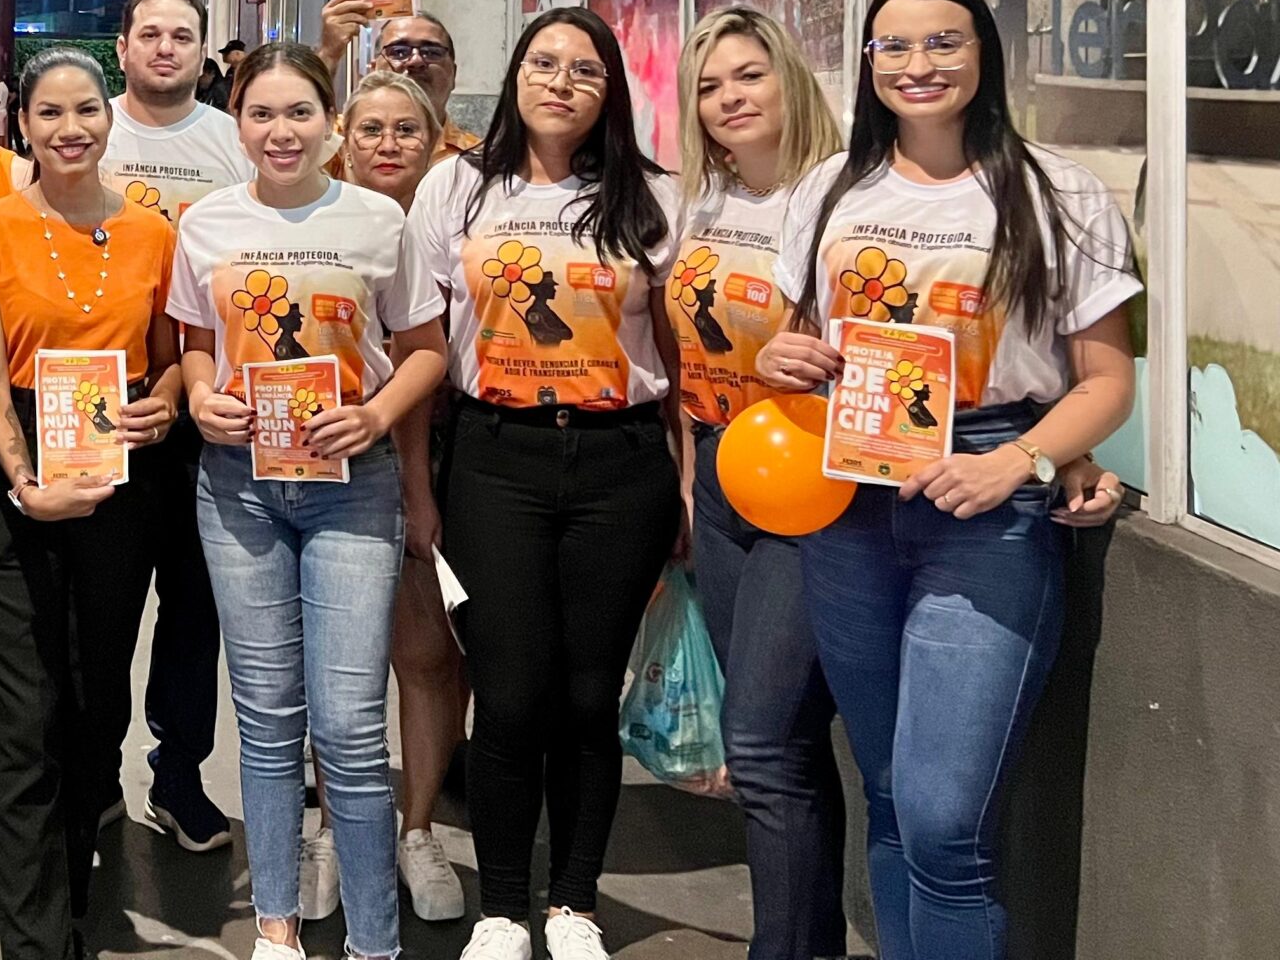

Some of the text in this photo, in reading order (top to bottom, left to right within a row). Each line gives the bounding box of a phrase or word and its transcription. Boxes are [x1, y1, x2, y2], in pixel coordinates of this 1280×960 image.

[122, 162, 157, 174] INFÂNCIA
[494, 220, 536, 233] INFÂNCIA
[852, 224, 907, 240] INFÂNCIA
[240, 250, 284, 261] INFÂNCIA
[594, 276, 613, 289] 100
[746, 288, 767, 304] 100
[845, 344, 895, 361] PROTEJA
[842, 362, 888, 394] DE
[254, 385, 293, 393] PROTEJA
[43, 391, 74, 414] DE
[256, 399, 290, 417] DE
[840, 390, 891, 414] NUN
[44, 414, 80, 429] NUN
[256, 419, 296, 432] NUN
[838, 408, 883, 436] CIE
[44, 429, 76, 449] CIE
[258, 431, 293, 449] CIE
